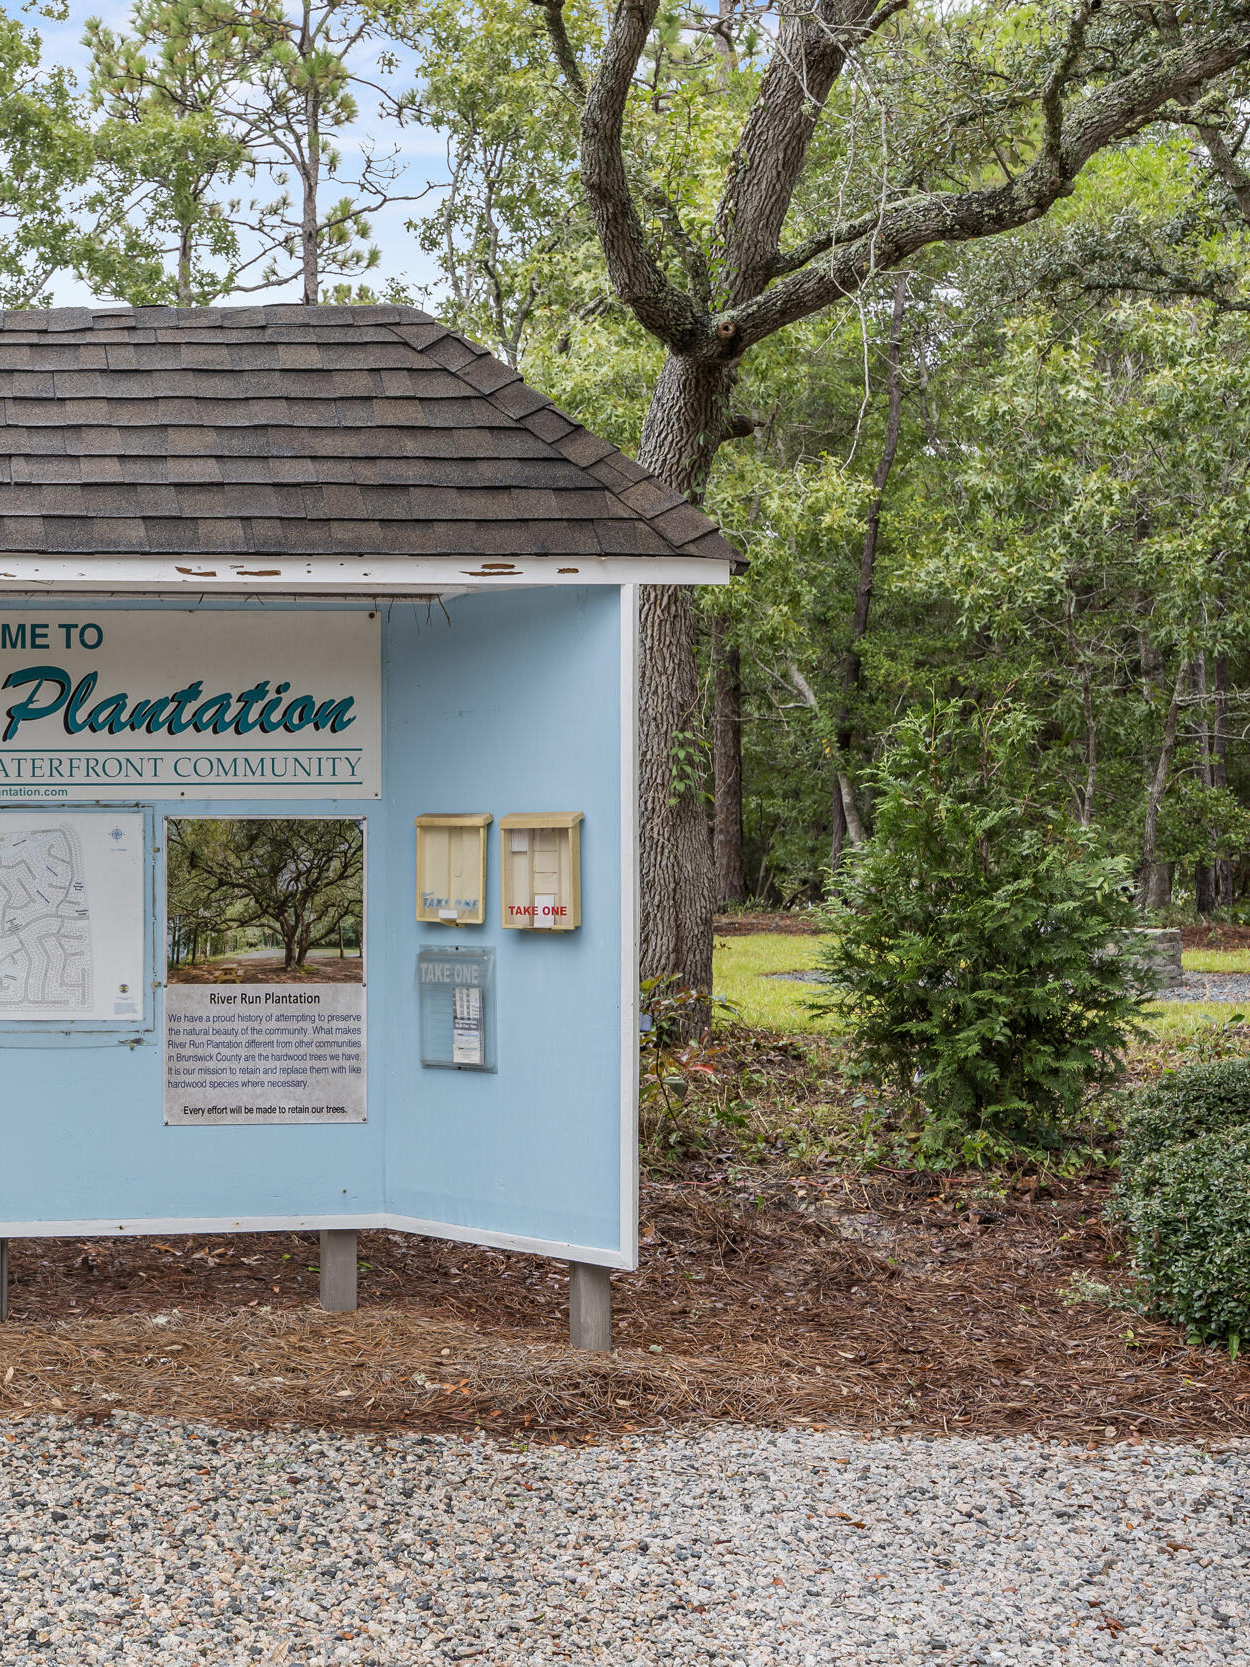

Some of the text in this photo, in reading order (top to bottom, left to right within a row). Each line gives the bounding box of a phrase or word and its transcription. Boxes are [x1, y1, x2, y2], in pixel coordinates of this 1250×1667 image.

[58, 623, 103, 649] TO
[1, 665, 356, 742] Plantation
[174, 756, 362, 777] COMMUNITY
[508, 905, 567, 916] TAKE ONE
[420, 963, 479, 984] TAKE ONE
[209, 992, 320, 1004] River Run Plantation
[168, 1014, 182, 1023] We
[184, 1014, 203, 1023] have
[212, 1014, 236, 1024] proud
[237, 1013, 263, 1024] history
[265, 1013, 273, 1022] of
[275, 1013, 315, 1024] attempting
[318, 1013, 325, 1022] to
[327, 1014, 361, 1024] preserve
[168, 1026, 361, 1037] the natural beauty of the community. What makes
[168, 1039, 361, 1049] River Run Plantation different from other communities
[168, 1053, 174, 1062] in
[176, 1053, 213, 1062] Brunswick
[215, 1052, 242, 1063] County
[243, 1054, 256, 1062] are
[257, 1053, 270, 1062] the
[271, 1052, 307, 1061] hardwood
[309, 1053, 327, 1061] trees
[341, 1052, 361, 1061] have.
[167, 1065, 361, 1076] It is our mission to retain and replace them with like
[167, 1079, 310, 1090] hardwood species where necessary.
[183, 1105, 347, 1117] Every effort will be made to retain our trees.
